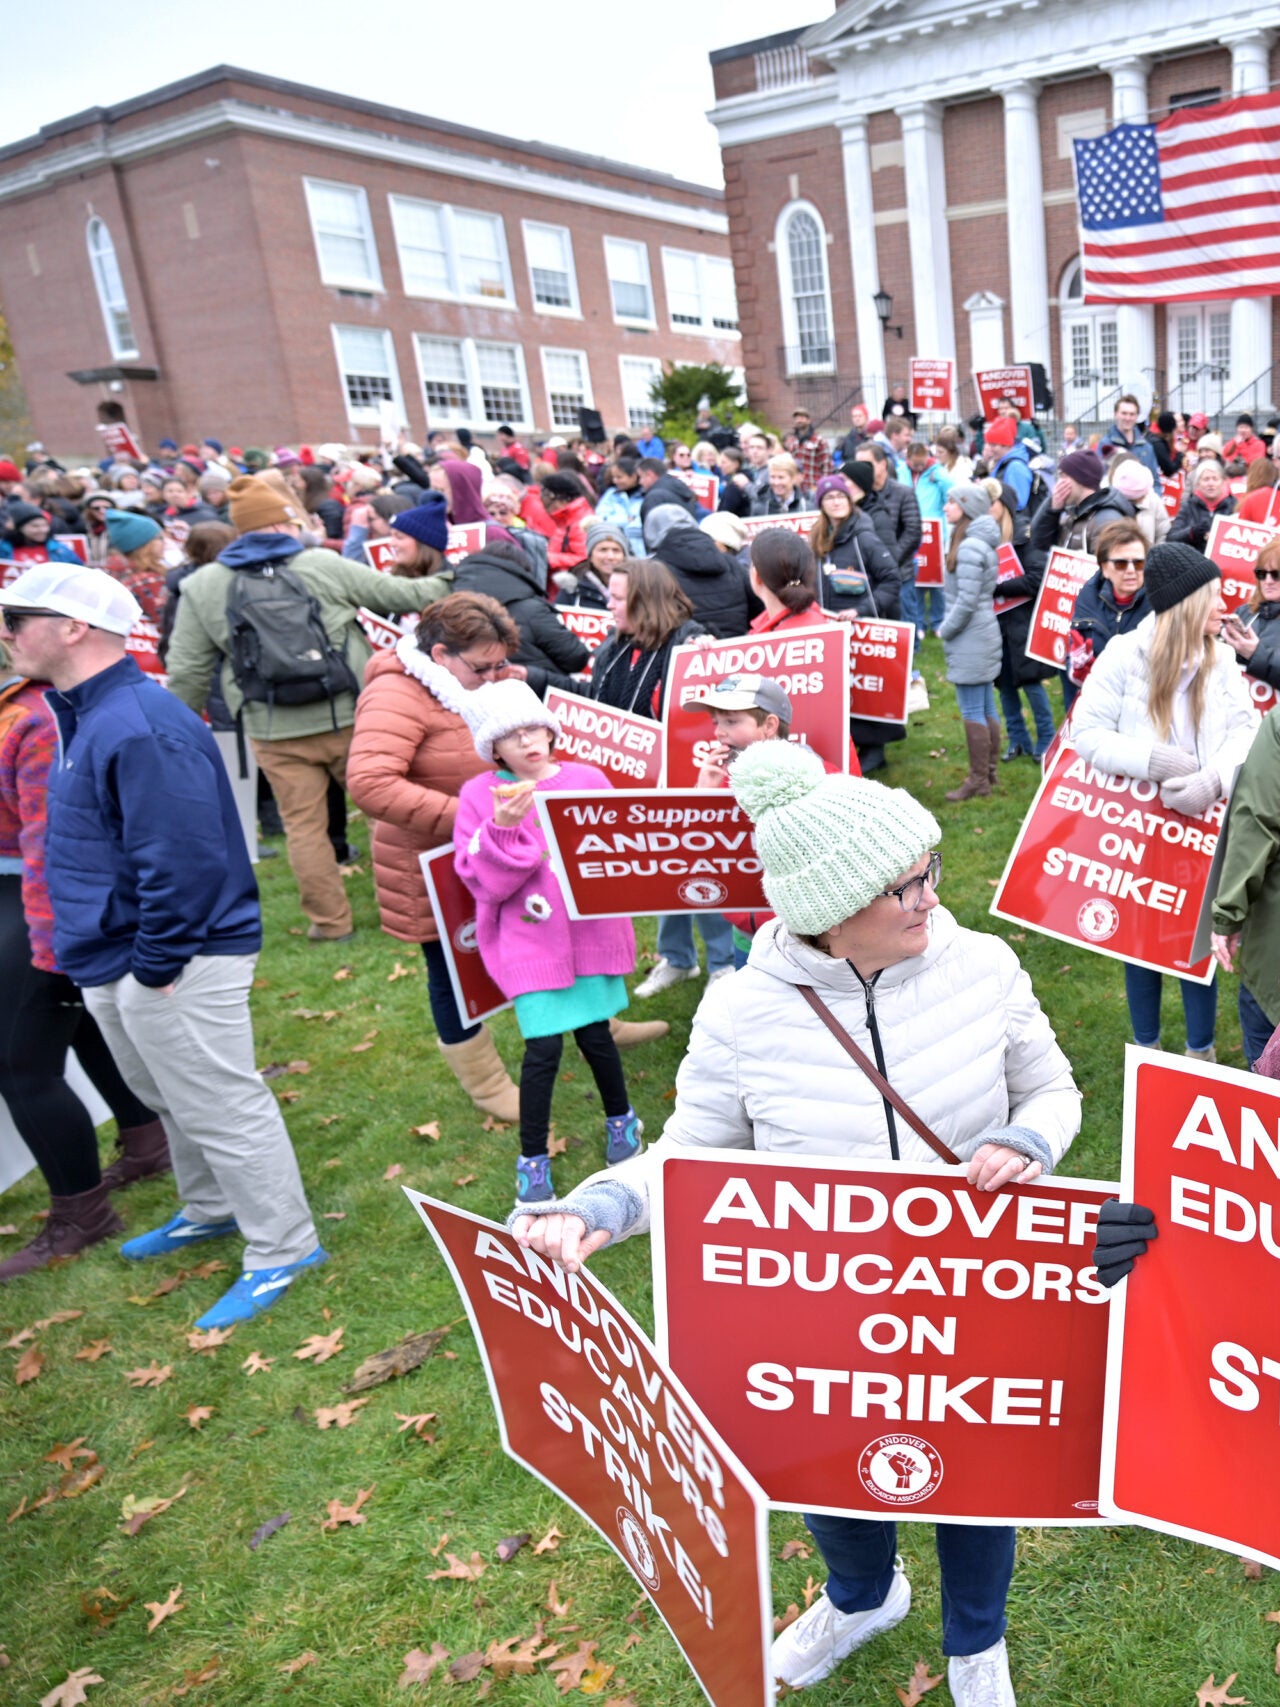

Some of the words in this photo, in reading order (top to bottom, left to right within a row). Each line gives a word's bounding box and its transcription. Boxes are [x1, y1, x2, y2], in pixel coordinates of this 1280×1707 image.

[1057, 597, 1073, 614] ON
[683, 638, 825, 680] ANDOVER
[553, 702, 657, 755] ANDOVER
[555, 731, 648, 780] DUCATORS
[563, 805, 618, 826] We
[626, 804, 741, 829] Support
[1050, 785, 1219, 857] EDUCATORS
[575, 831, 757, 855] ANDOV
[1098, 833, 1147, 865] ON
[577, 857, 764, 879] EDUCATO
[1042, 847, 1188, 916] STRIKE!
[703, 1245, 1112, 1305] EDUCATORS
[859, 1313, 957, 1356] ON
[474, 1230, 726, 1510] ANDOVER
[745, 1361, 1064, 1427] STRIKE!
[482, 1269, 729, 1558] EDUCATORS
[600, 1397, 652, 1486] ON
[878, 1436, 927, 1451] ANDOVER
[539, 1381, 715, 1631] STRIKE!
[865, 1479, 897, 1502] EDUCATION
